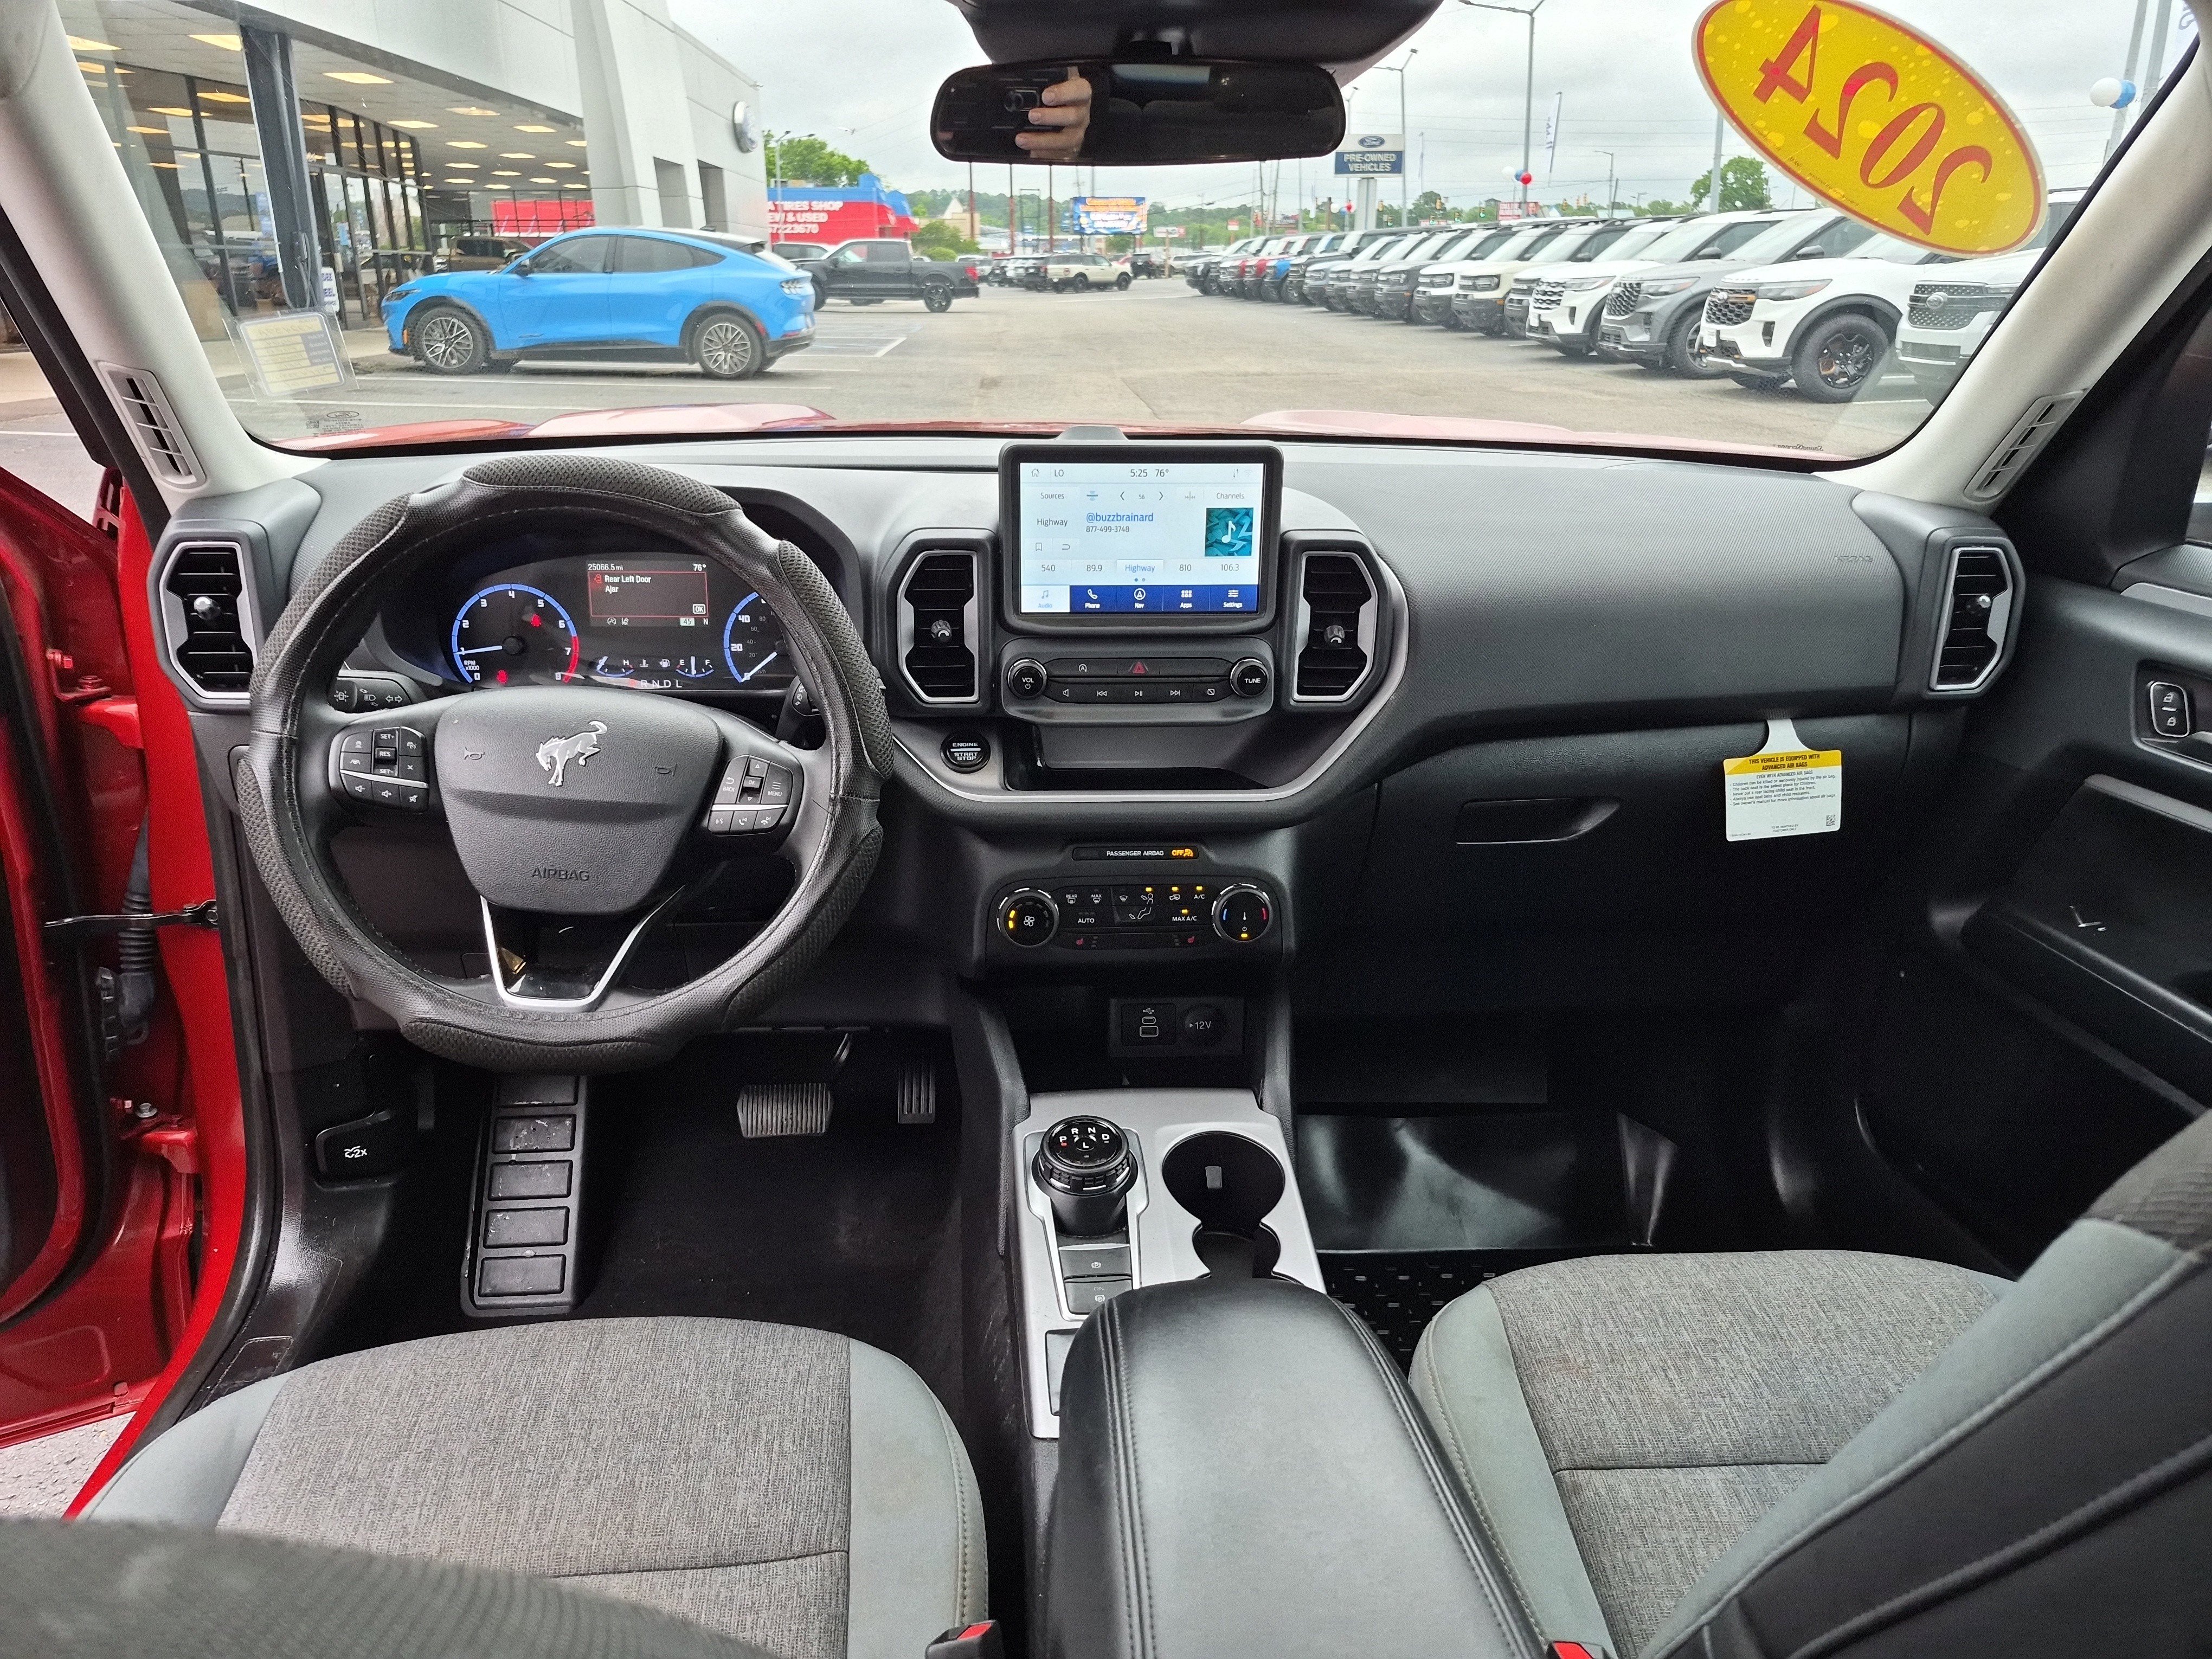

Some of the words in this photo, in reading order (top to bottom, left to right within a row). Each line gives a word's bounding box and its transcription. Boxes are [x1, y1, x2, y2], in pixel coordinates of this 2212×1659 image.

[1348, 163, 1392, 171] VEHICLES
[811, 201, 843, 211] SHOP
[787, 212, 796, 222] &
[796, 212, 828, 222] USED
[1130, 469, 1148, 477] 5:25
[1086, 512, 1153, 523] @buzzbrainard
[1037, 518, 1068, 526] Highway
[1125, 564, 1155, 573] Highway
[605, 586, 619, 594] Ajar
[738, 615, 750, 623] 40
[532, 867, 589, 881] AIRBAG
[1195, 1021, 1211, 1029] 12V
